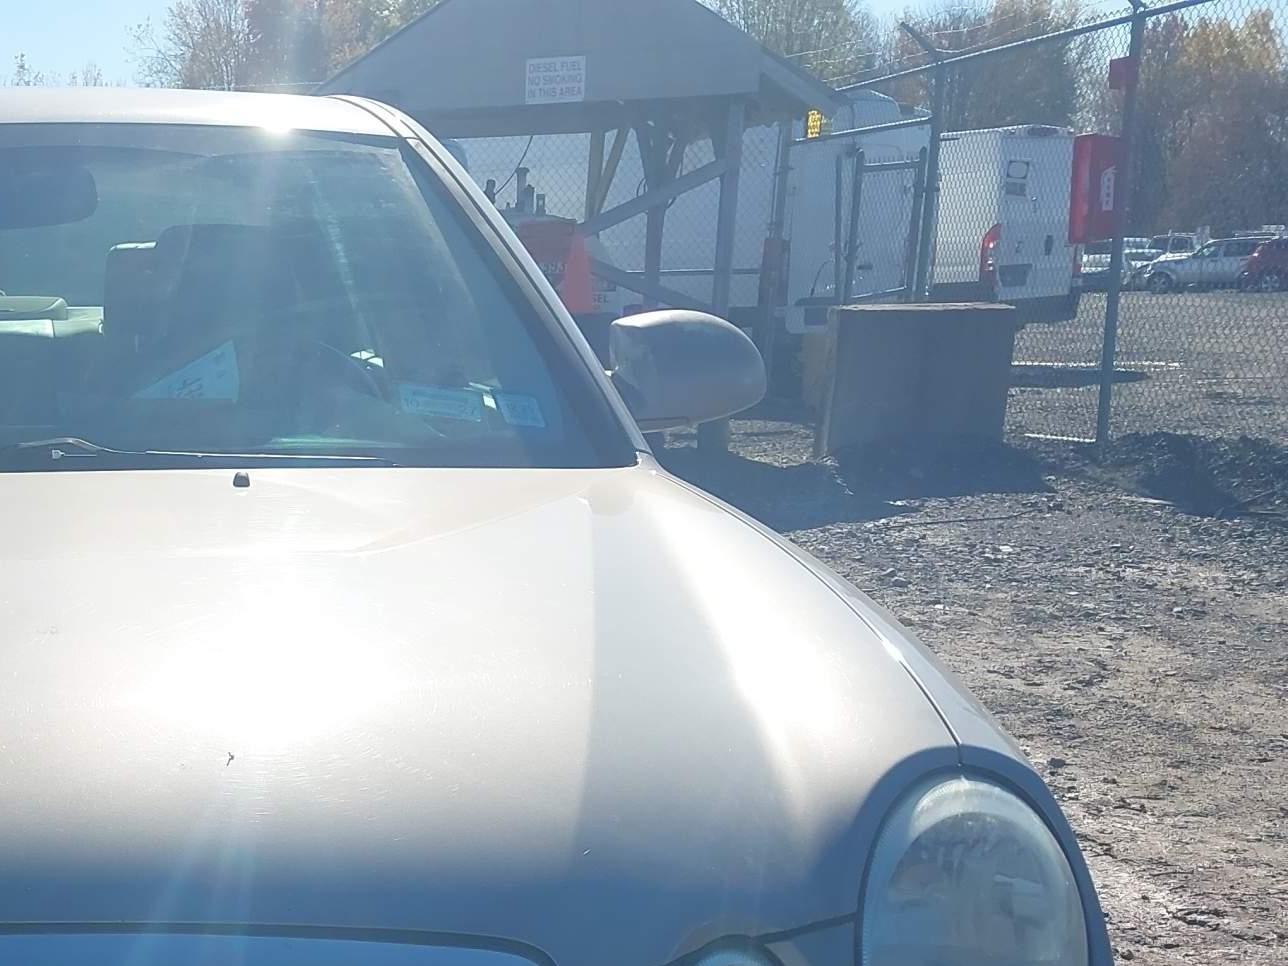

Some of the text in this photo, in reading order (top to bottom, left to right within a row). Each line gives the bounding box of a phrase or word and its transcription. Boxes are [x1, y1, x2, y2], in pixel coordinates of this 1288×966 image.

[528, 61, 582, 73] DIESEL FUEL
[528, 73, 583, 86] NO SMOKING
[527, 86, 583, 98] IN THIS AREA
